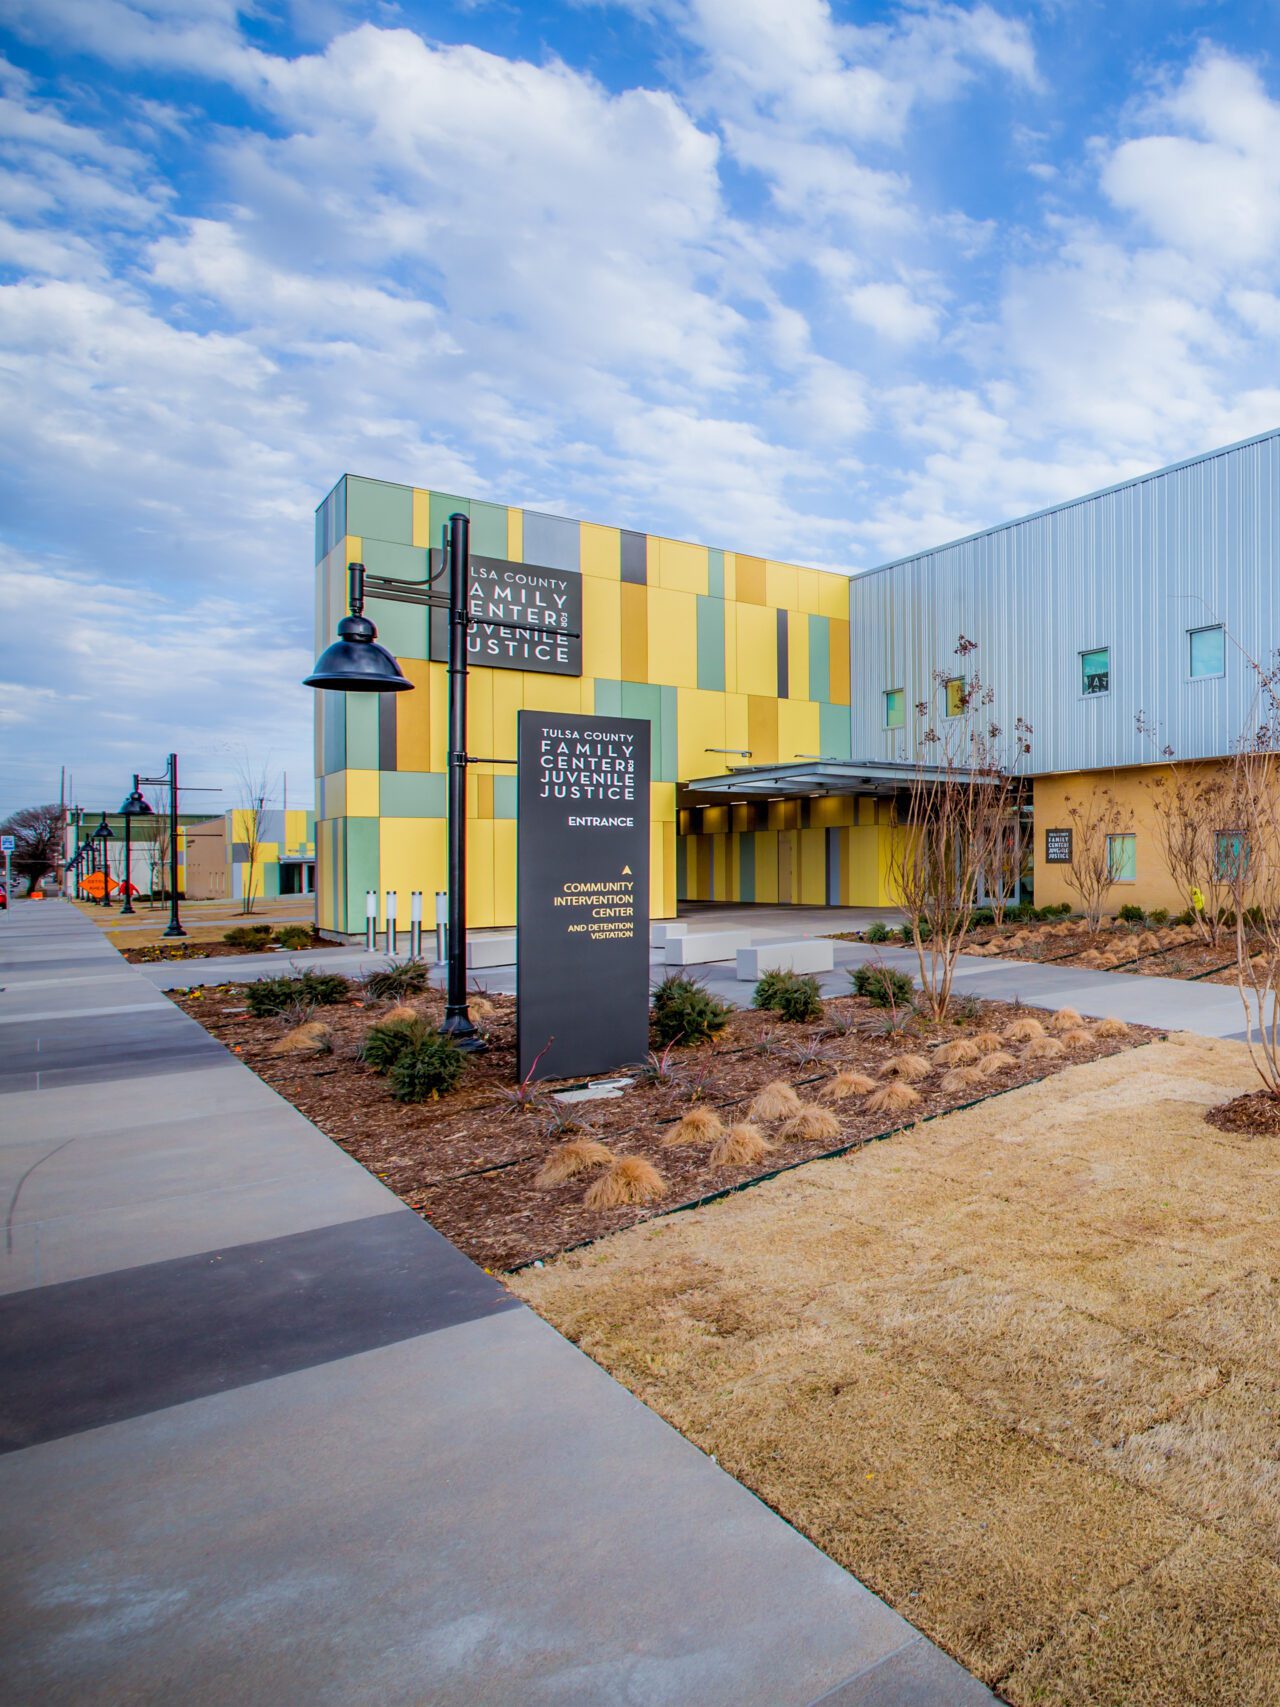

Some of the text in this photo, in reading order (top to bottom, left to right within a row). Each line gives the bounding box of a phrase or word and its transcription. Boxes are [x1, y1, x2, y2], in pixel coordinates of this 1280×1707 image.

[470, 566, 567, 591] LSA COUNTY
[469, 582, 567, 608] AMILY
[470, 600, 557, 626] ENTER
[560, 612, 568, 628] FOR
[467, 619, 569, 645] UVENILE
[467, 636, 569, 663] USTICE
[542, 728, 634, 742] TULSA COUNTY
[541, 740, 634, 758] FAMILY
[540, 755, 625, 772] CENTER
[627, 760, 635, 772] FOR
[540, 770, 635, 786] JUVENILE
[540, 785, 635, 801] JUSTICE
[568, 816, 634, 827] ENTRANCE
[564, 882, 633, 892] COMMUNITY
[554, 895, 633, 906] INTERVENTION
[592, 907, 634, 918] CENTER
[567, 922, 634, 932] AND DETENTION
[591, 930, 634, 940] VISITATION
